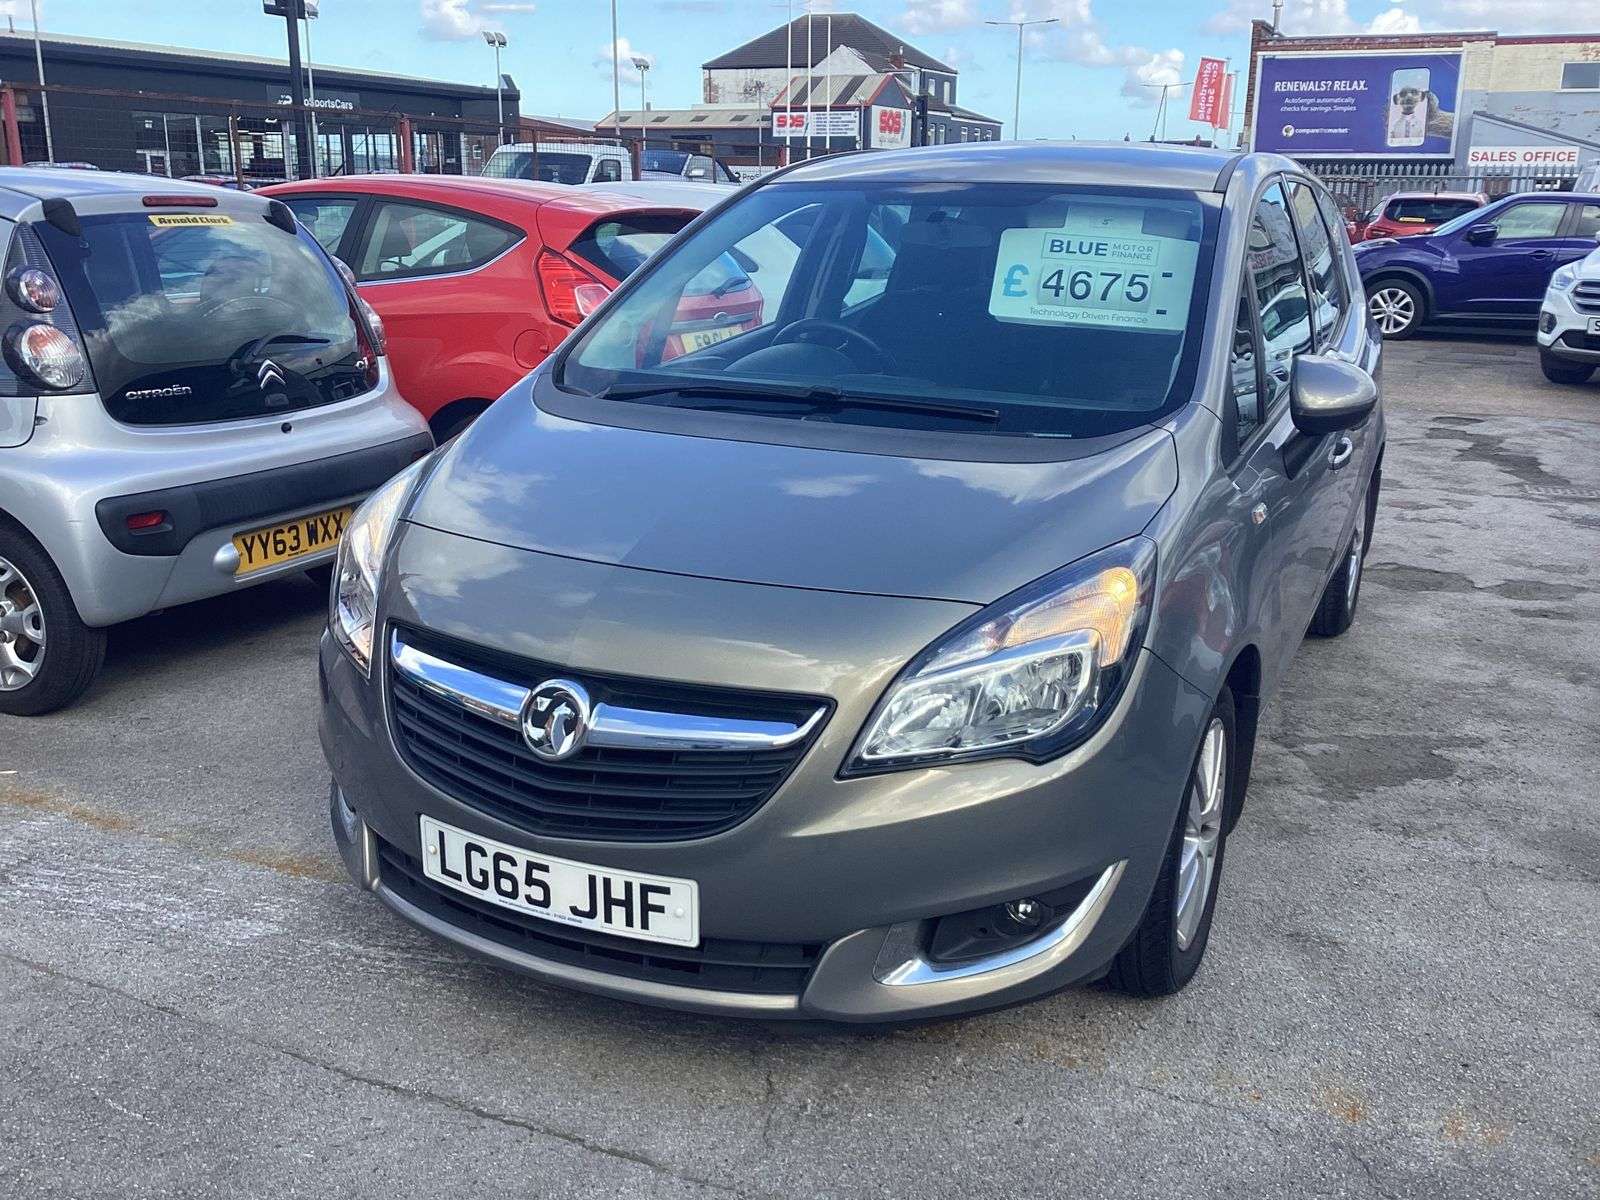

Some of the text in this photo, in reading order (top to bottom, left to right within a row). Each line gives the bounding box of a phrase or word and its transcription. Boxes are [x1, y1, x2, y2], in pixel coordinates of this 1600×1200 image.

[1275, 80, 1368, 91] RENEWALS? RELAX.
[777, 114, 805, 128] SOS
[880, 109, 901, 134] SOS
[1471, 151, 1577, 162] SALES OFFICE
[1049, 239, 1153, 256] BLUE MOTOR
[1112, 251, 1152, 260] FINANCE
[1003, 264, 1149, 302] £ 4675
[1030, 306, 1149, 324] Technology Driven Finance
[126, 384, 192, 400] CITROËN
[241, 512, 343, 564] YY63 WXX
[438, 830, 671, 930] LG65 JHF
